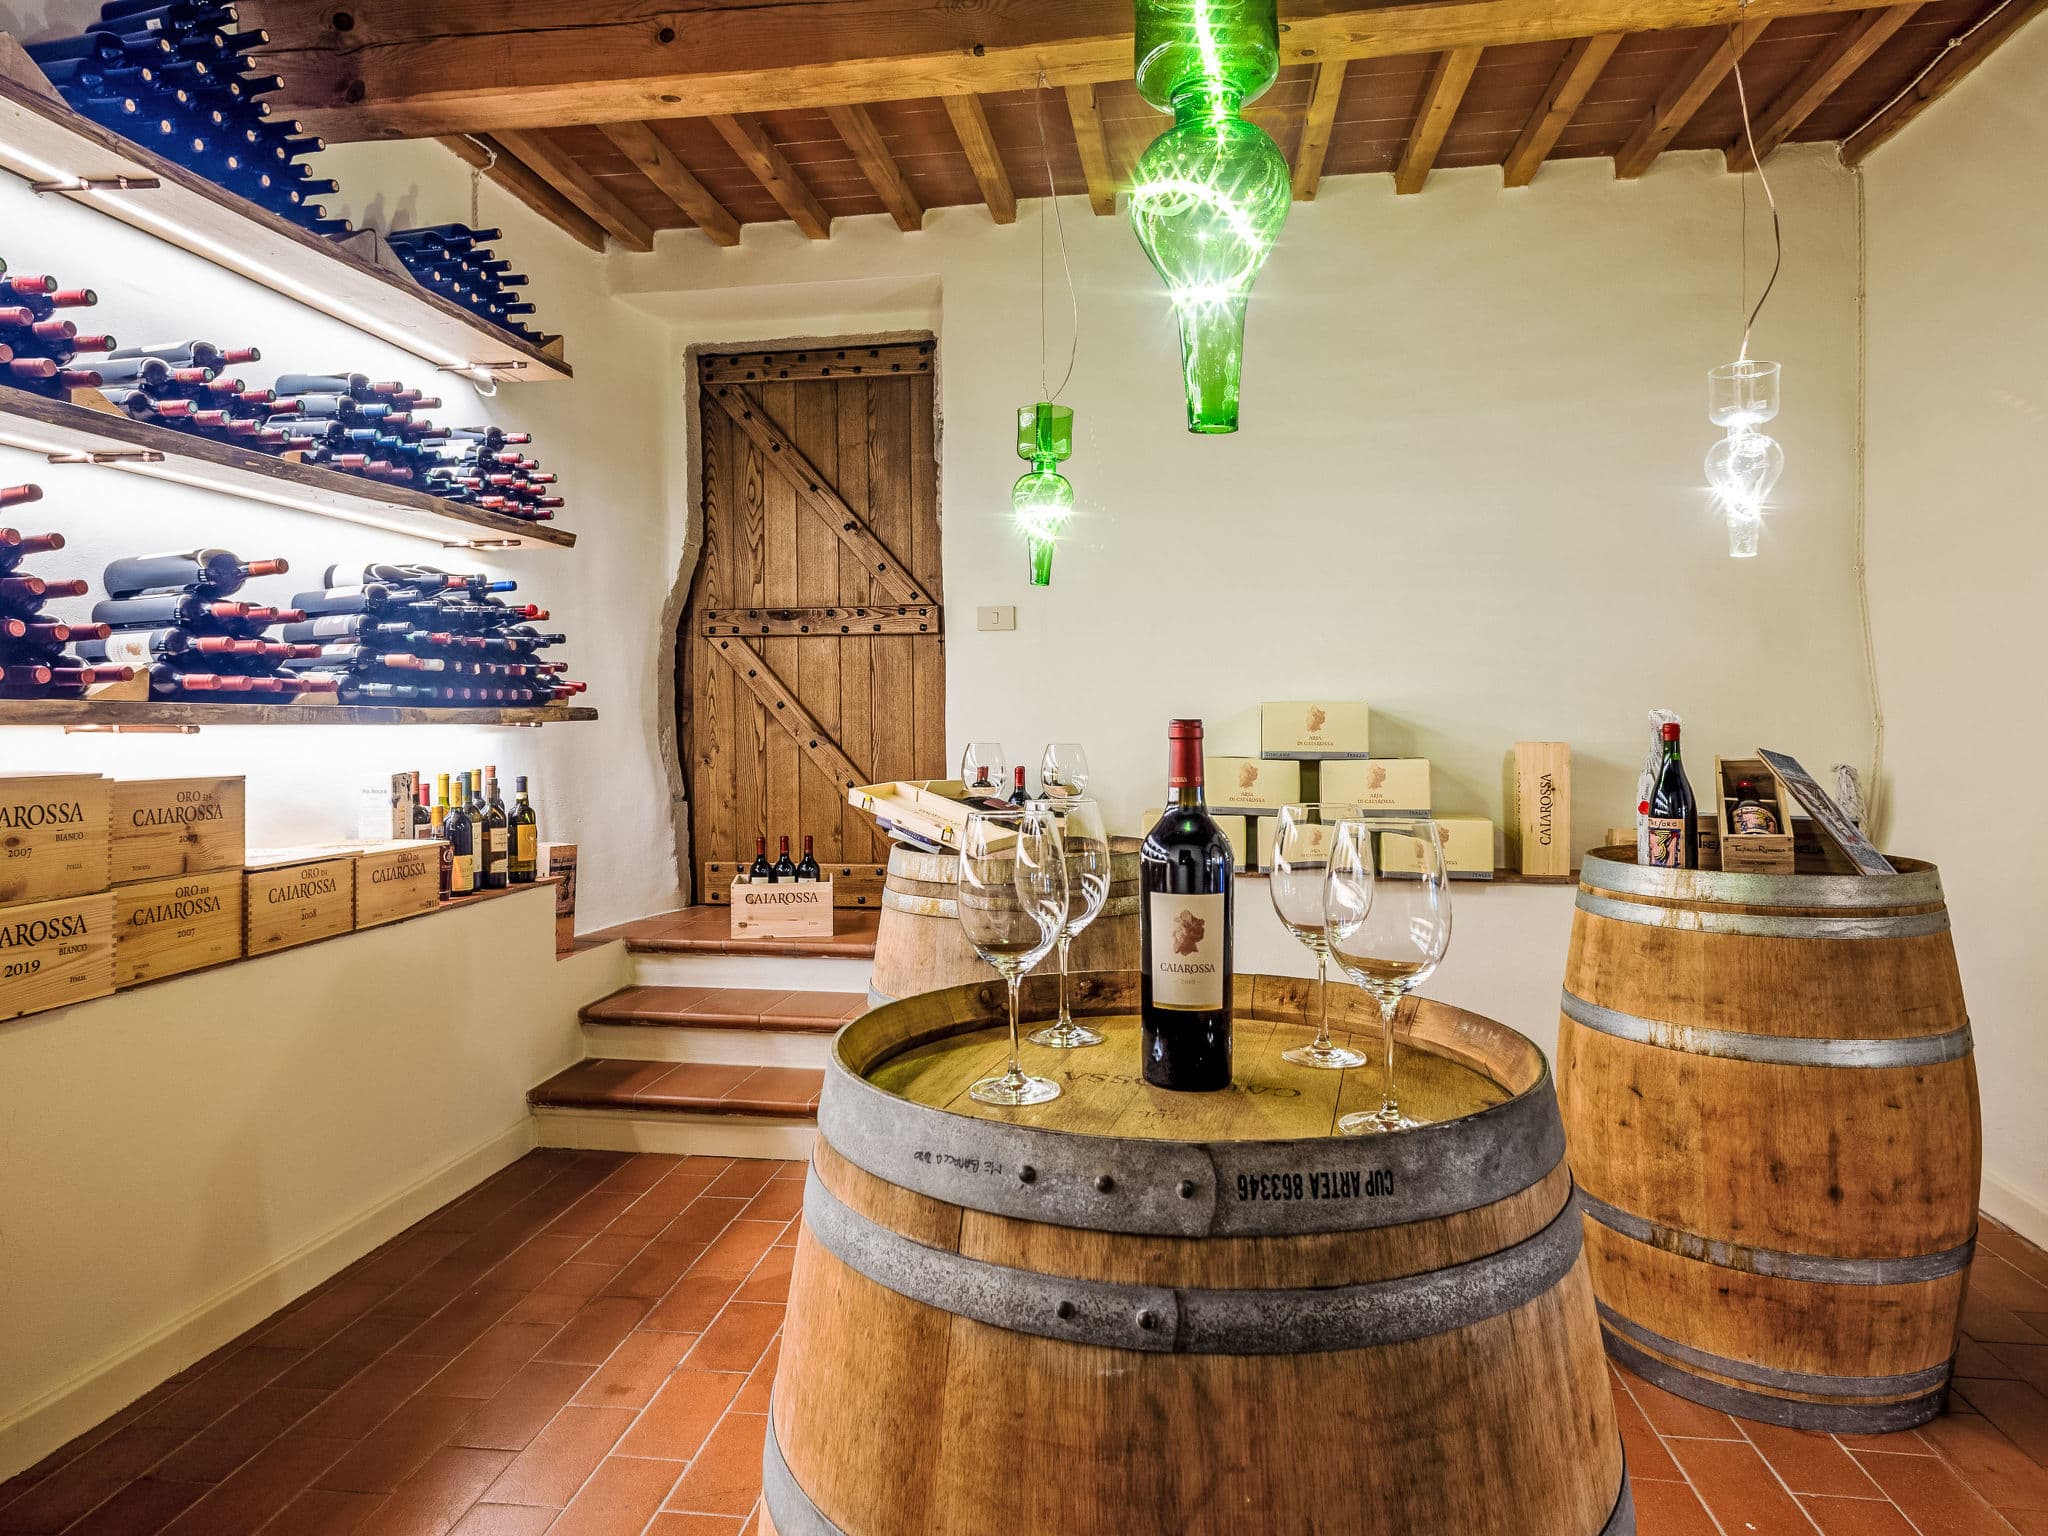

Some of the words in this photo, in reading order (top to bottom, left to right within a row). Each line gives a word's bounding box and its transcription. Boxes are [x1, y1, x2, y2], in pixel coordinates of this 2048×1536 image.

[176, 791, 201, 803] ORO
[132, 804, 223, 827] CAIAROSSA
[1540, 773, 1553, 846] CAIAROSSA
[55, 832, 84, 842] BIANCO
[8, 848, 32, 858] 2007
[397, 853, 412, 863] ORO
[301, 868, 319, 880] ORO
[372, 862, 426, 883] CAIAROSSA
[176, 885, 199, 898] ORO
[201, 887, 209, 895] DI
[268, 878, 336, 904] CAIAROSSA
[745, 892, 819, 905] CAIAROSSA
[133, 896, 221, 926] CAIAROSSA
[301, 908, 317, 920] 2008
[177, 928, 196, 938] 2007
[58, 943, 88, 956] BIANCO
[4, 959, 40, 978] 2019
[1160, 962, 1216, 975] CAIAROSSA
[1237, 1173, 1304, 1201] 863346
[1309, 1171, 1360, 1199] ARTEA
[1365, 1170, 1394, 1197] CUP
